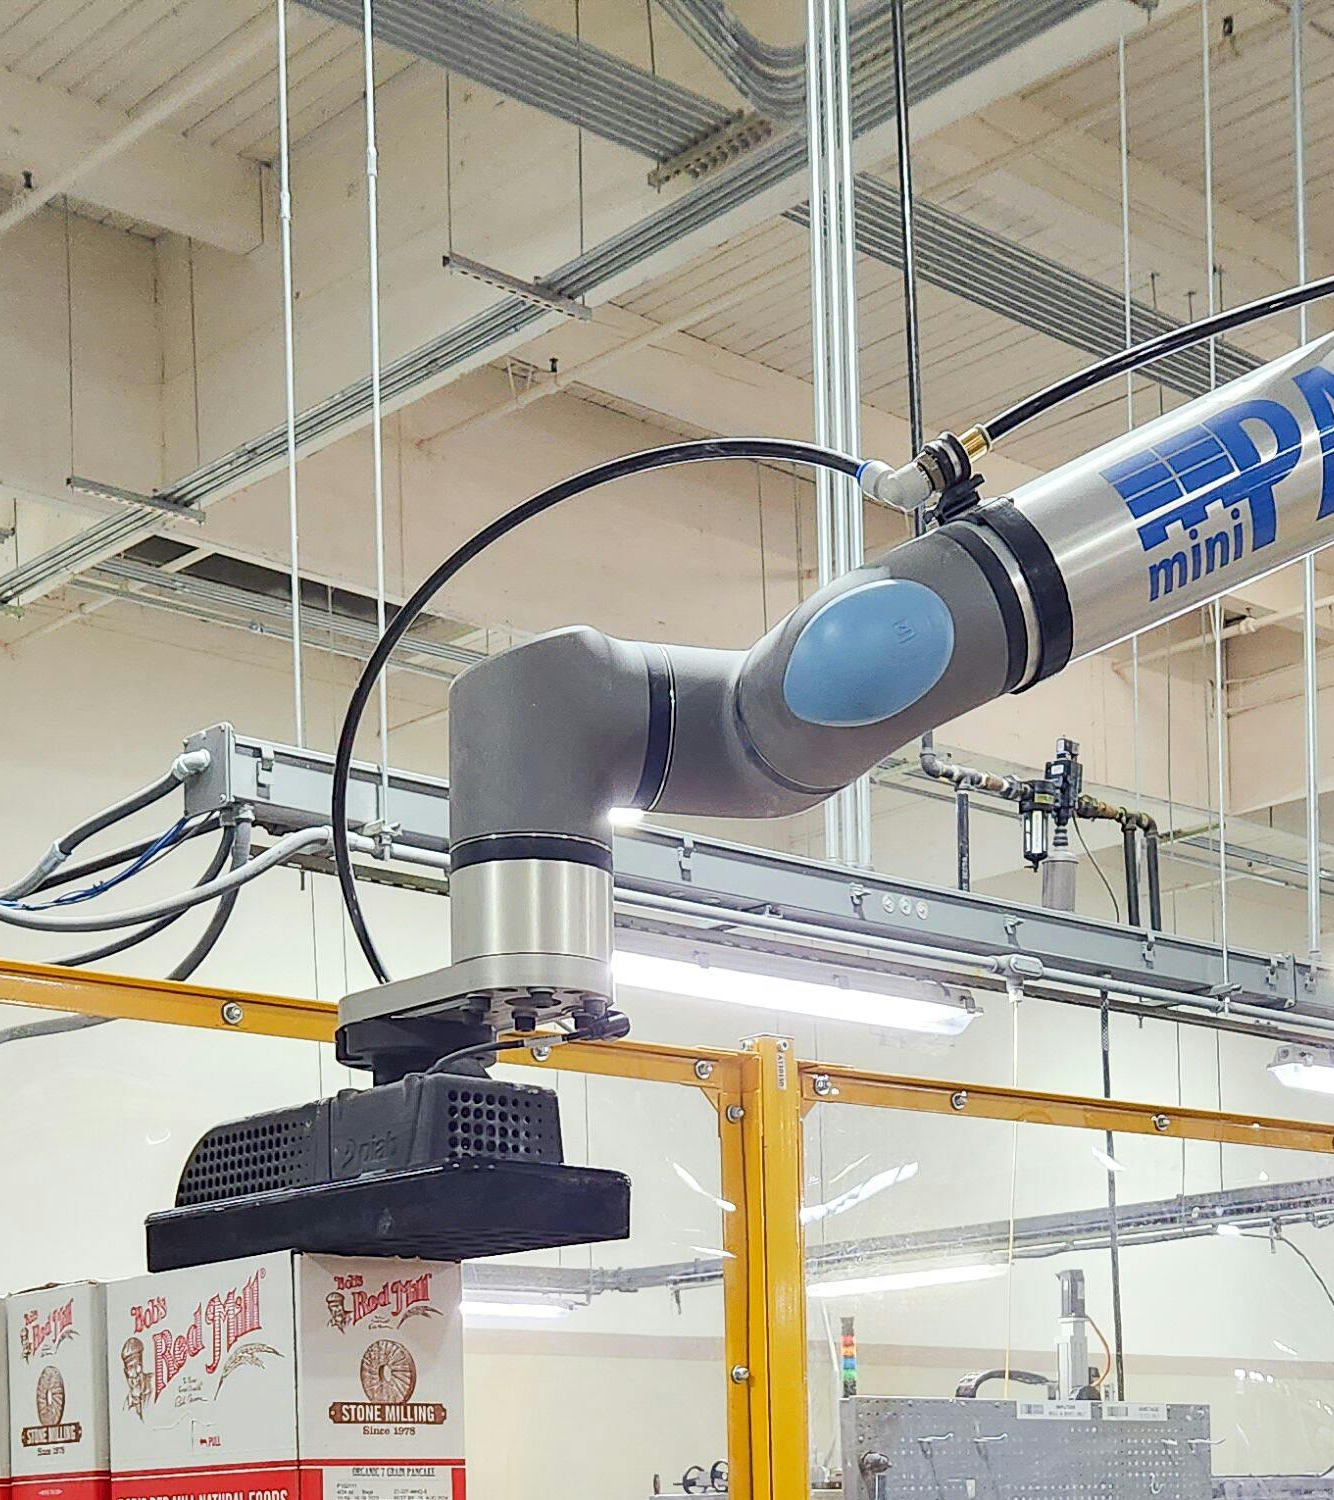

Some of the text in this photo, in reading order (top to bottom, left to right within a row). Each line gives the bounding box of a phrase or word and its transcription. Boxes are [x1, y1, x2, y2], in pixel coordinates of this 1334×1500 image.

[1149, 509, 1244, 601] mini
[334, 1275, 363, 1290] Bob's
[352, 1273, 432, 1325] Red Mill
[131, 1297, 167, 1334] Bob's
[153, 1270, 262, 1403] Red Mill
[342, 1404, 434, 1422] STONE MILLING
[363, 1426, 416, 1435] Since 1978
